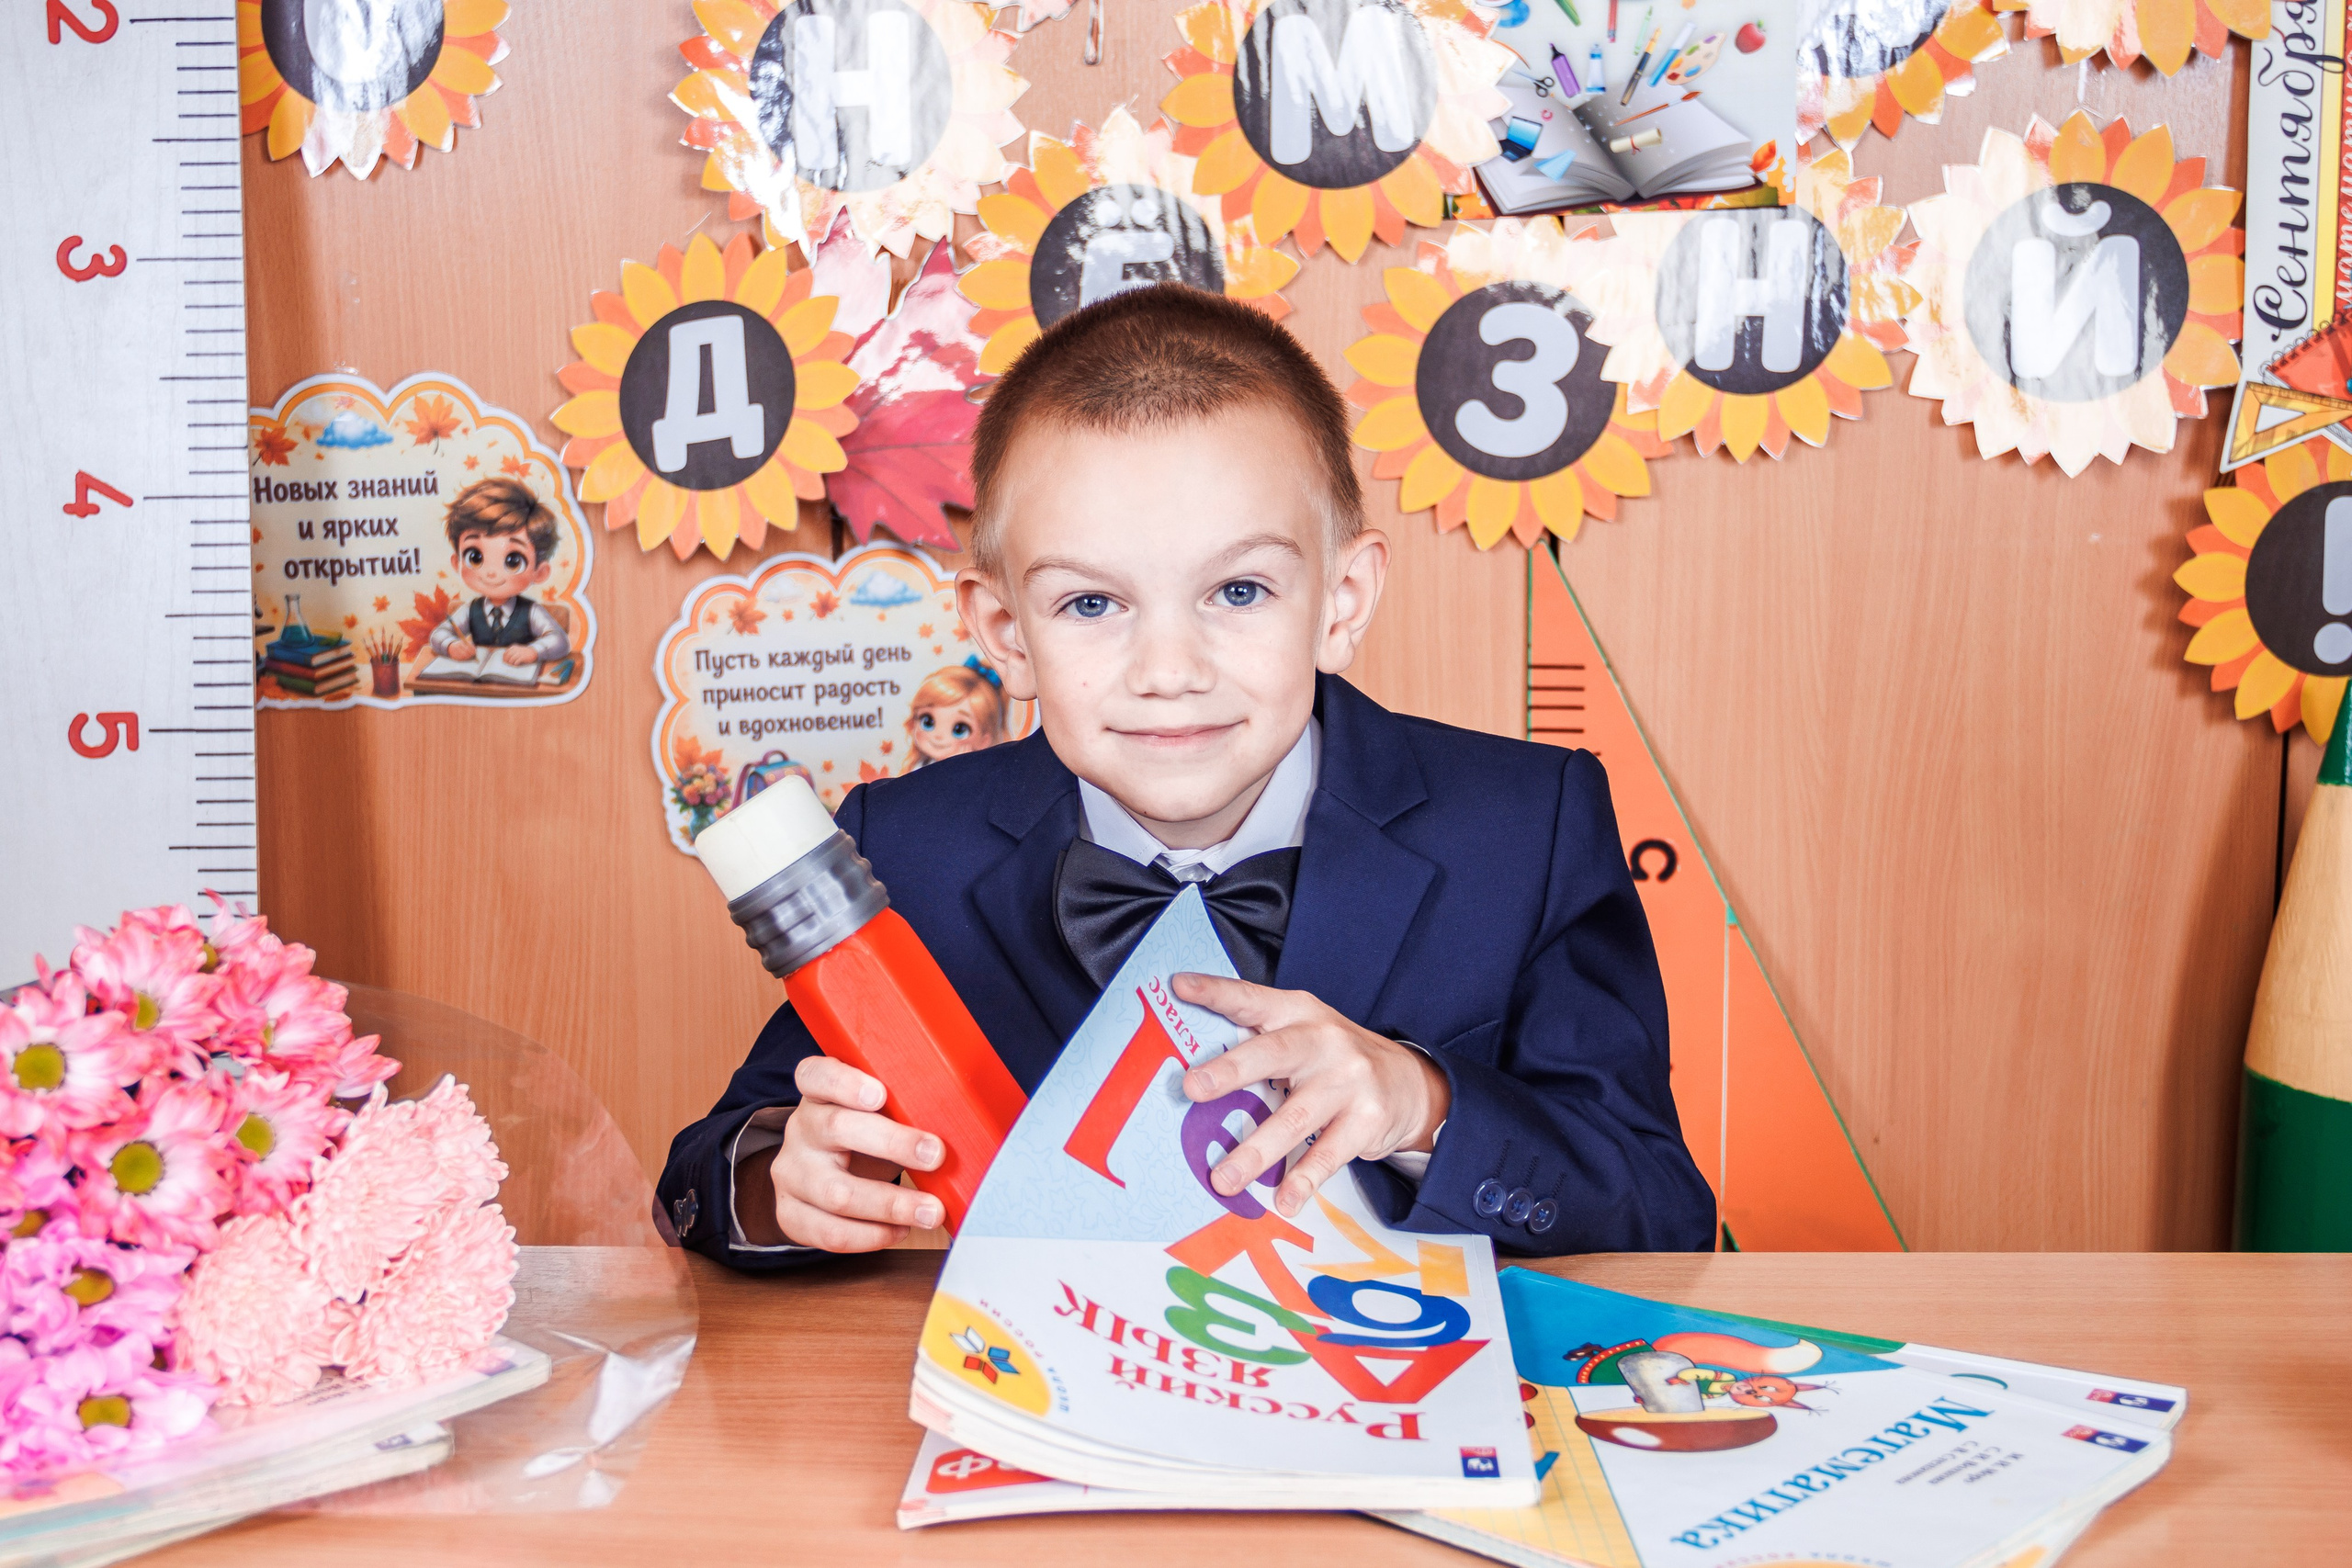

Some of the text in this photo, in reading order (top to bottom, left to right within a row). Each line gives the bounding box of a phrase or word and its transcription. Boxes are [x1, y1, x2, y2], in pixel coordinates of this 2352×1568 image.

[46, 0, 119, 44] 2
[56, 235, 128, 282] 3
[62, 469, 134, 518] 4
[254, 470, 438, 503] Новых знаний
[298, 517, 400, 547] и ярких
[284, 547, 422, 586] открытий!
[695, 643, 912, 679] Пусть каждый день
[703, 679, 900, 711] приносит радость
[68, 711, 140, 759] 5
[718, 707, 884, 741] и вдохновение!
[1148, 976, 1201, 1056] класс
[1063, 986, 1191, 1190] 1
[1105, 1353, 1430, 1441] Русский
[1669, 1395, 1996, 1551] Математика
